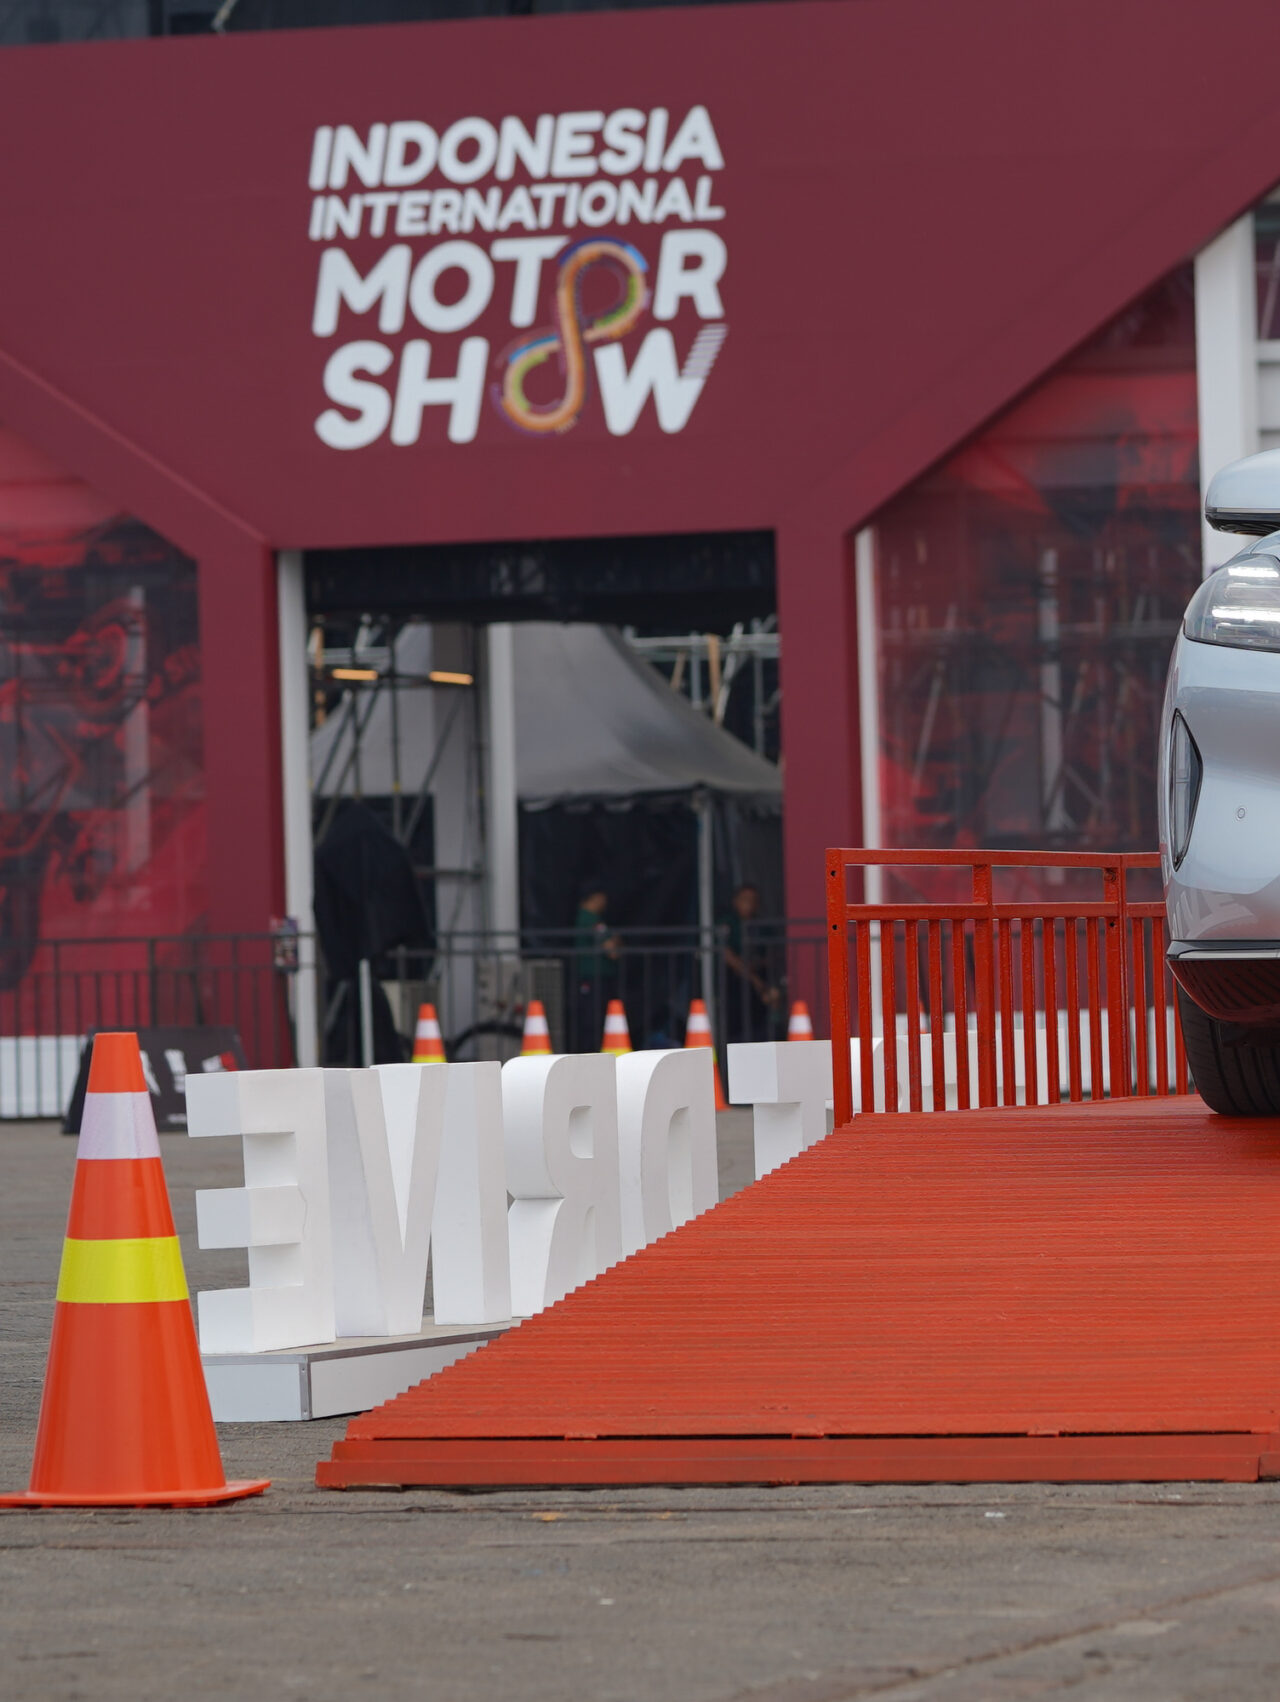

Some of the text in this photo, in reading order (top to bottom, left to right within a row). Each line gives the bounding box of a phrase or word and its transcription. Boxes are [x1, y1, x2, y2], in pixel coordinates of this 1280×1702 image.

[309, 105, 725, 191] INDONESIA
[309, 175, 725, 241] INTERNATIONAL
[312, 229, 728, 338] MOTOR
[314, 324, 728, 451] SHOW
